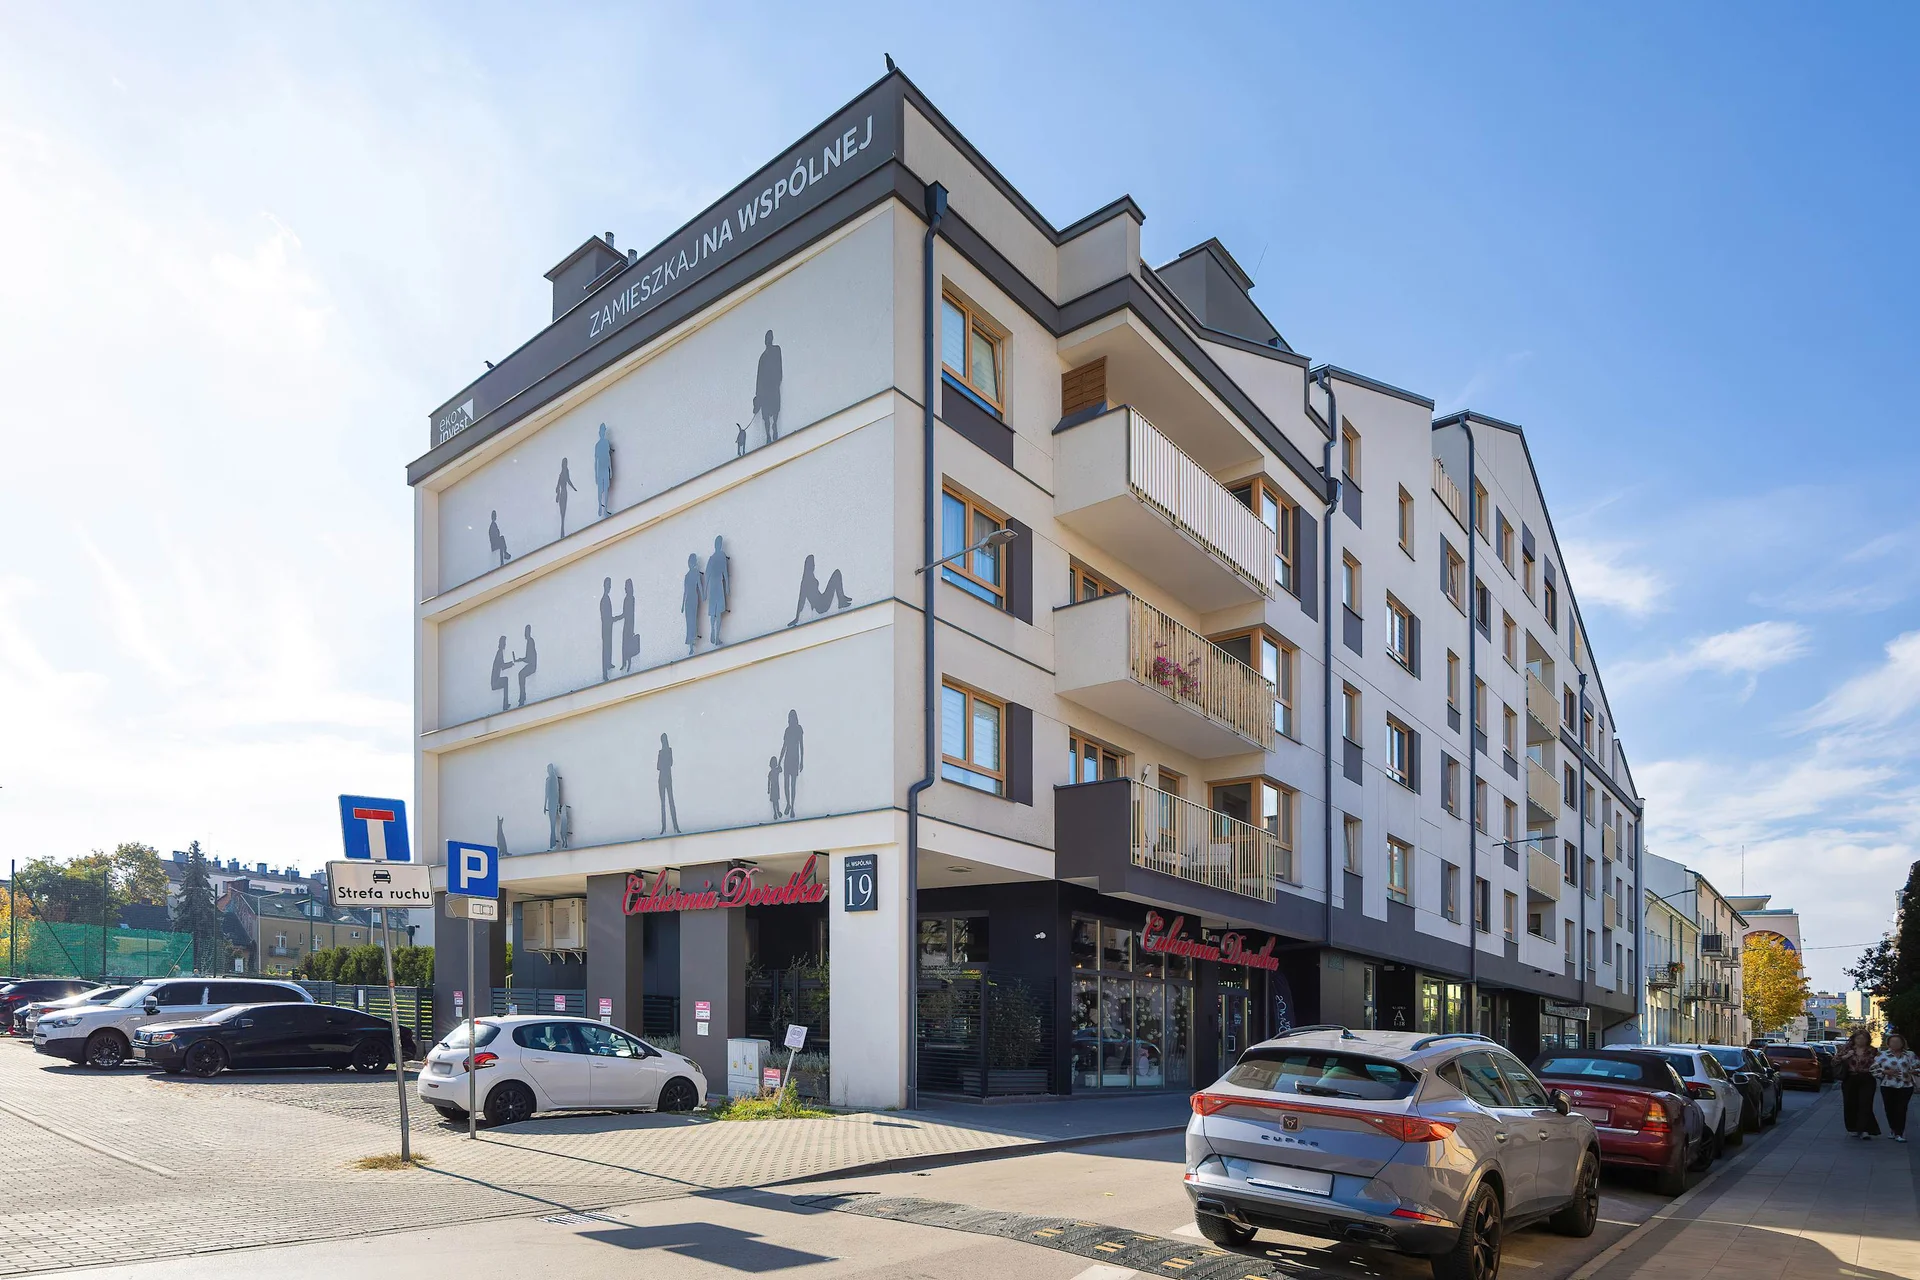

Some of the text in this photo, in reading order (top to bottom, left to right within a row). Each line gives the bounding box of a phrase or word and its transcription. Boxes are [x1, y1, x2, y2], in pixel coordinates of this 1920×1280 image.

[589, 115, 873, 338] ZAMIESZKAJ NA WSPÓLNEJ
[440, 410, 457, 432] eko
[440, 414, 469, 443] invest
[460, 848, 488, 889] P
[338, 886, 430, 900] Strefa ruchu
[622, 853, 828, 916] Cukiernia Dorotka
[846, 873, 873, 907] 19
[1141, 910, 1279, 971] Cukiernia Dorotka
[1393, 1009, 1406, 1021] A
[1261, 1134, 1319, 1147] CUPRA
